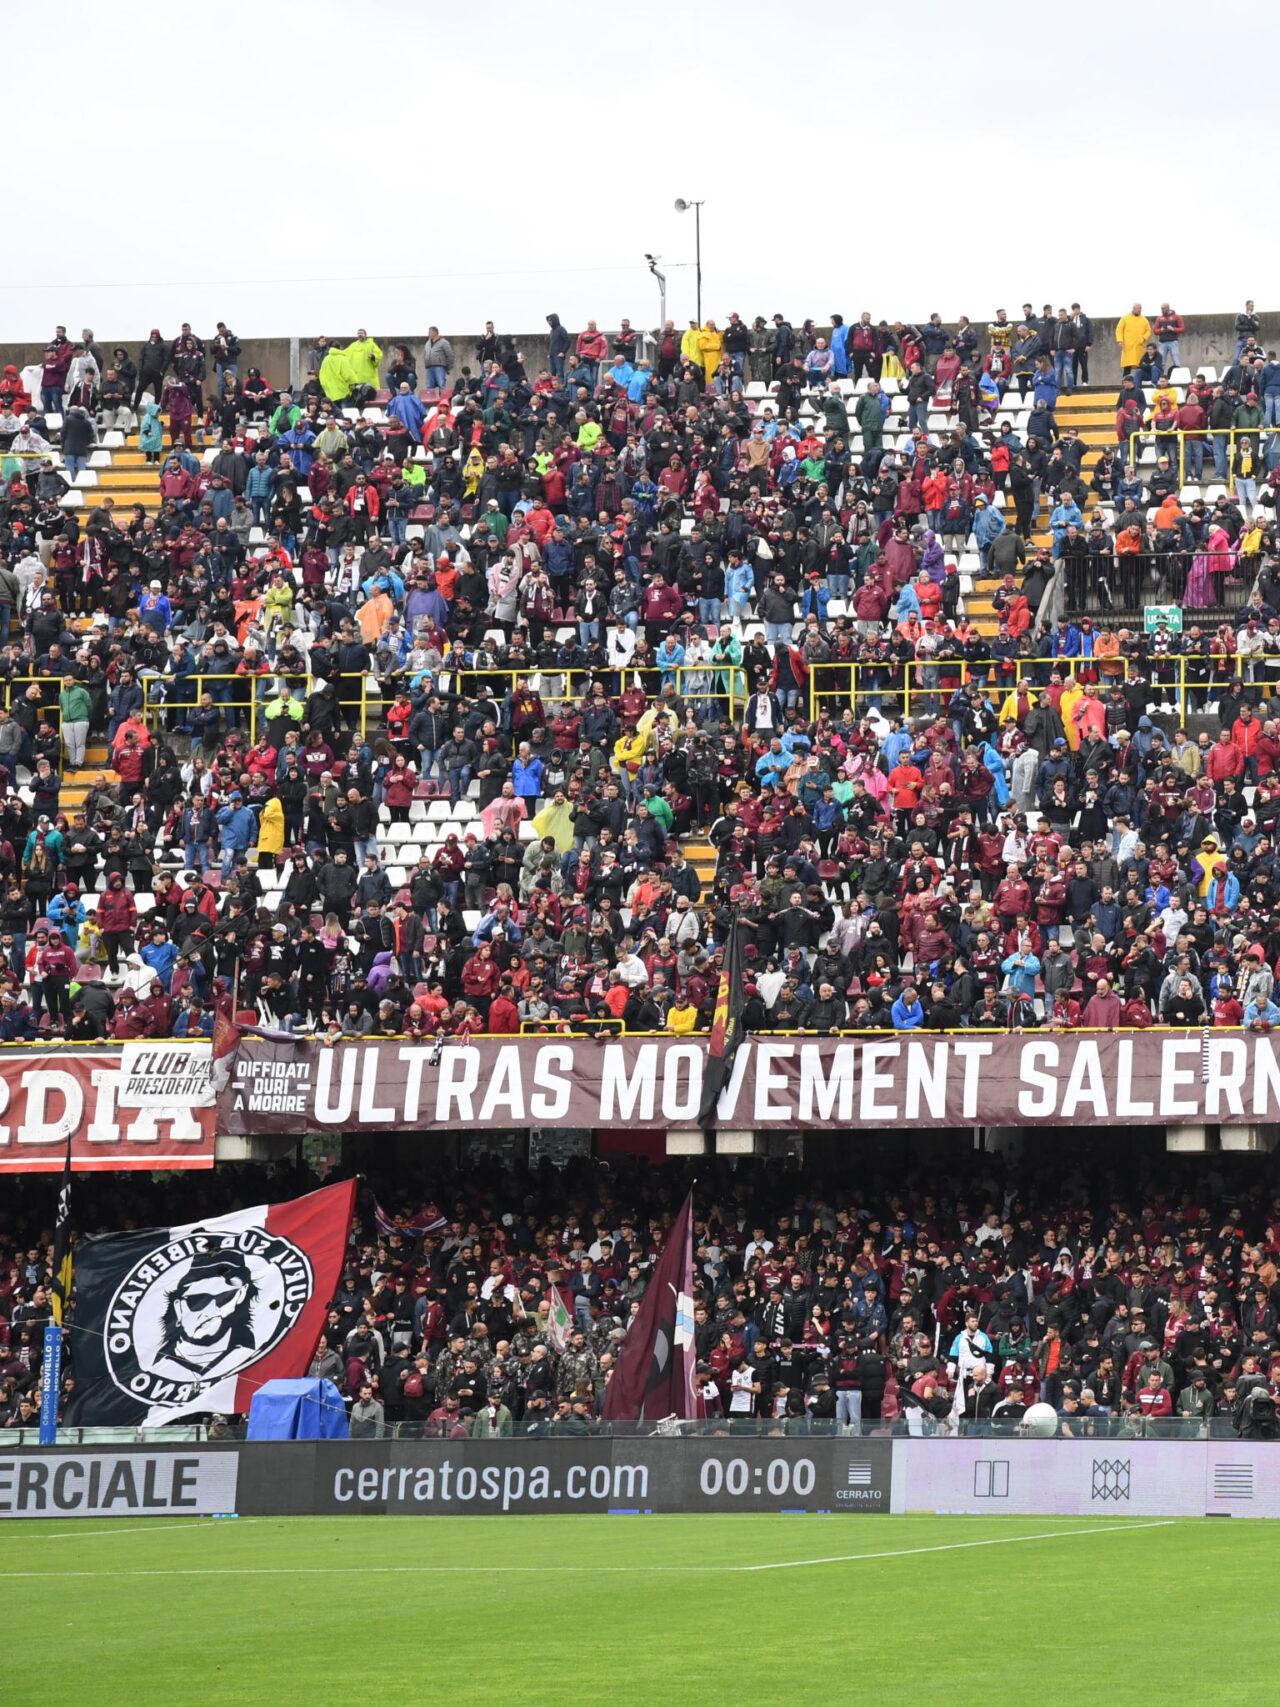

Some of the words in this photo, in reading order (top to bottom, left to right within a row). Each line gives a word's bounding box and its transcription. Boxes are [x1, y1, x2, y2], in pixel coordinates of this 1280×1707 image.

[1147, 615, 1180, 625] USTA
[131, 1052, 191, 1075] CLUB
[237, 1061, 310, 1078] DIFFIDATI
[125, 1077, 209, 1095] PRESIDENTE
[254, 1078, 288, 1094] DURI
[313, 1046, 574, 1122] ULTRAS
[600, 1040, 990, 1121] MOVEMENT
[0, 1068, 204, 1143] DIA
[234, 1095, 244, 1111] A
[248, 1095, 306, 1112] MORIRE
[43, 1345, 52, 1392] NOVIELLO
[334, 1462, 648, 1511] cerratospa.com
[699, 1456, 816, 1497] 00:00
[836, 1490, 882, 1500] CERRATO
